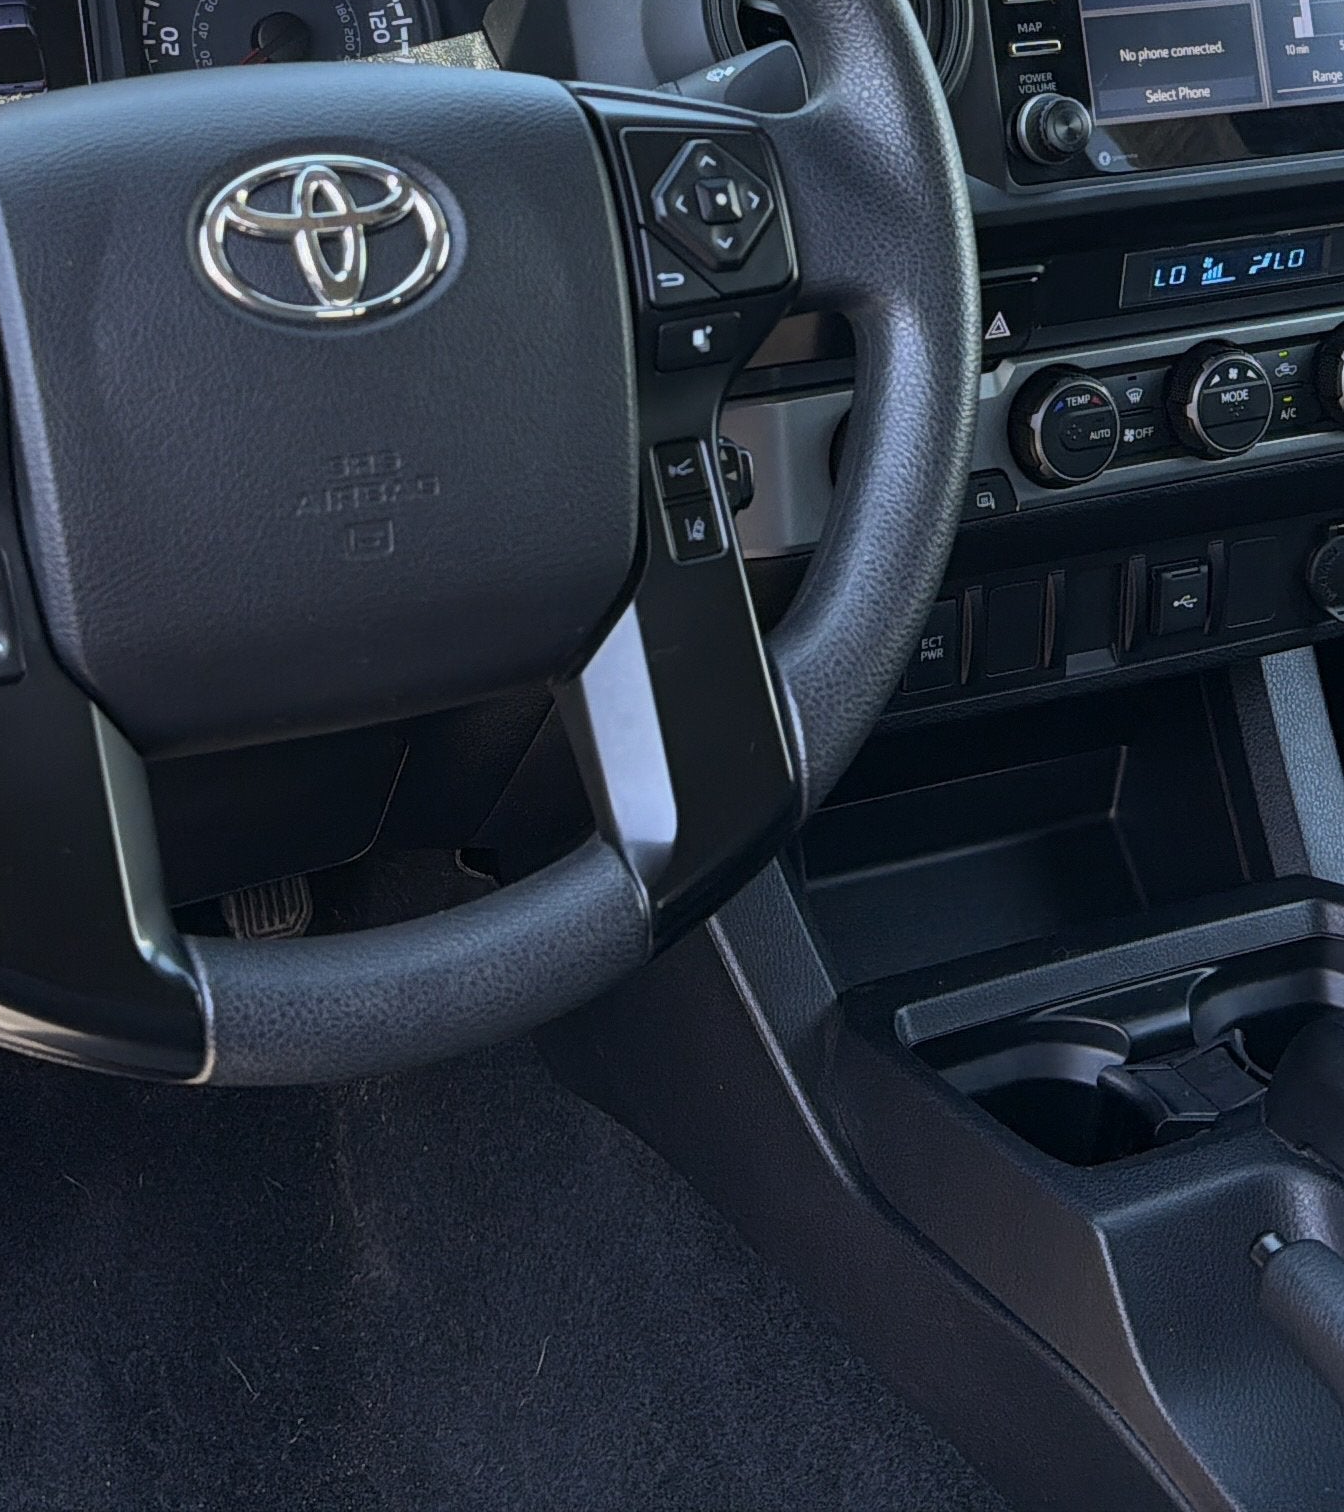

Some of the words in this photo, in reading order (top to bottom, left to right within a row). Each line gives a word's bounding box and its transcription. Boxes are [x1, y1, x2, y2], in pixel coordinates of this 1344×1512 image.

[335, 3, 350, 23] 180
[368, 9, 390, 44] 120
[1017, 22, 1043, 33] MAP
[160, 27, 179, 56] 20
[1119, 49, 1136, 62] No
[1138, 47, 1169, 63] phone
[1171, 41, 1225, 57] connected.
[1285, 45, 1296, 55] 10
[1296, 44, 1310, 54] min
[1019, 72, 1053, 83] POWER
[1312, 70, 1343, 84] Range
[1018, 82, 1057, 94] VOLUME
[1146, 89, 1177, 103] Select
[1178, 86, 1210, 100] Phone
[1273, 249, 1305, 270] LO
[1154, 265, 1187, 287] LO
[1066, 394, 1090, 407] TEMP
[1221, 389, 1249, 403] MODE
[1280, 407, 1296, 420] A/C
[1089, 429, 1110, 440] AUTO
[1136, 426, 1154, 439] OFF
[921, 635, 944, 649] ECT
[920, 648, 944, 662] PWR
